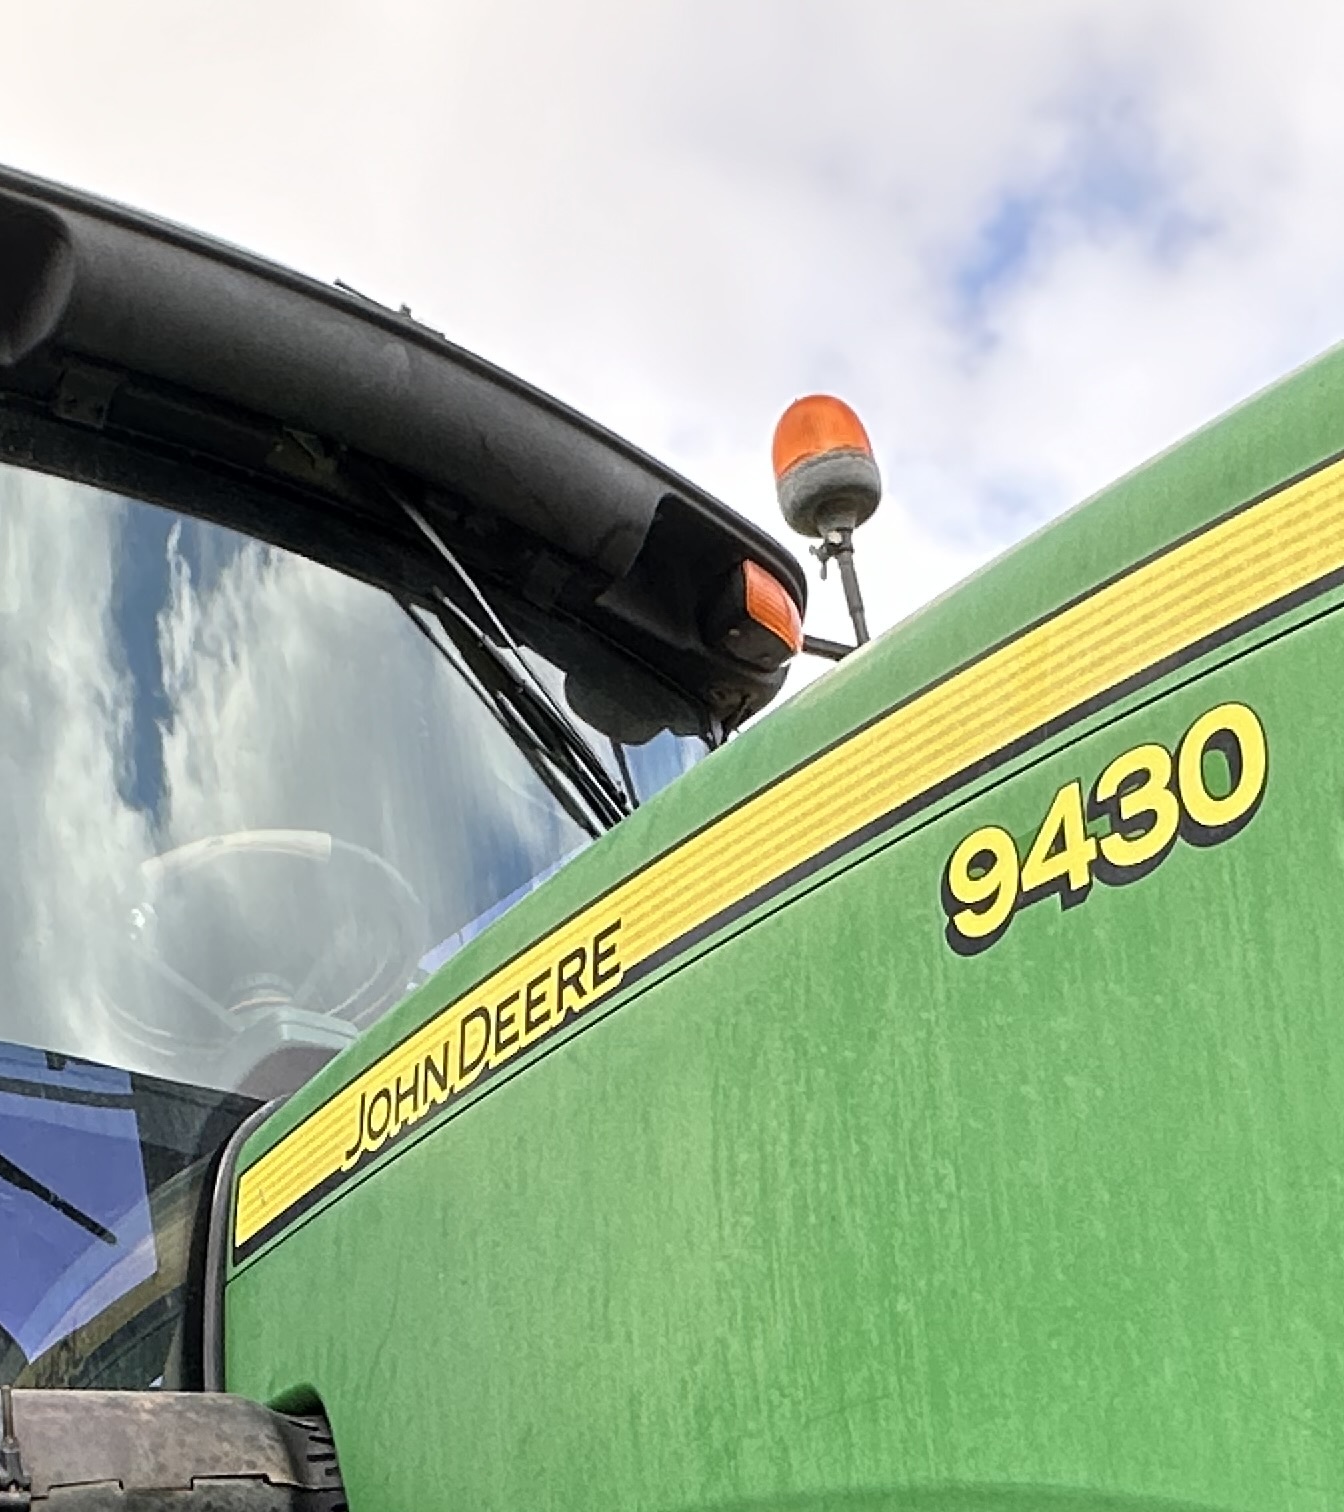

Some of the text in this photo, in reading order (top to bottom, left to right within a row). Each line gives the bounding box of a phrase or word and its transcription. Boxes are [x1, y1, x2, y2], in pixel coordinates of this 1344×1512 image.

[942, 701, 1269, 956] 9430
[343, 918, 622, 1161] JOHN DEERE
